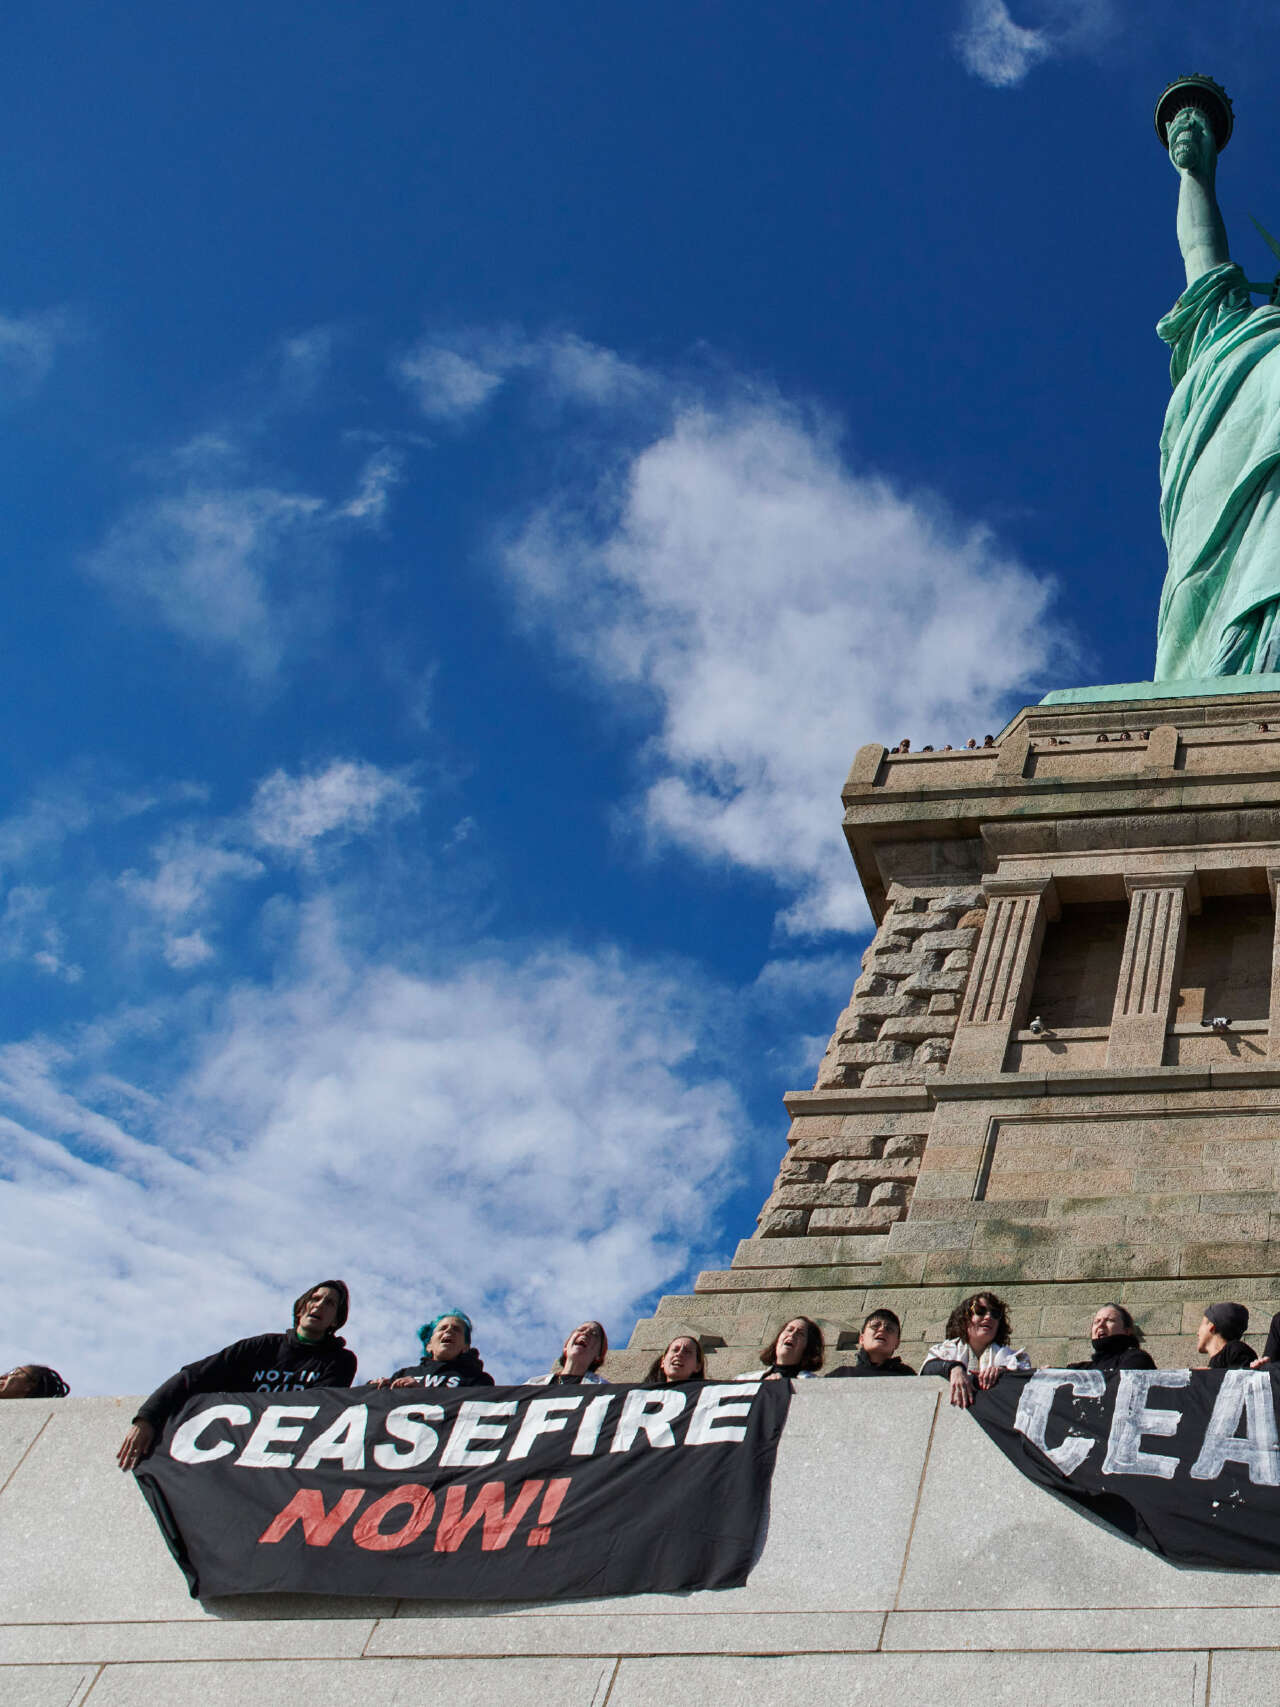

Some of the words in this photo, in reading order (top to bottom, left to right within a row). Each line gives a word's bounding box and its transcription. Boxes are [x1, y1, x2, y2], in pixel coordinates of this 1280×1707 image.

[252, 1370, 296, 1382] NOT
[300, 1370, 320, 1382] IN
[169, 1382, 761, 1470] CEASEFIRE
[258, 1477, 572, 1552] NOW!
